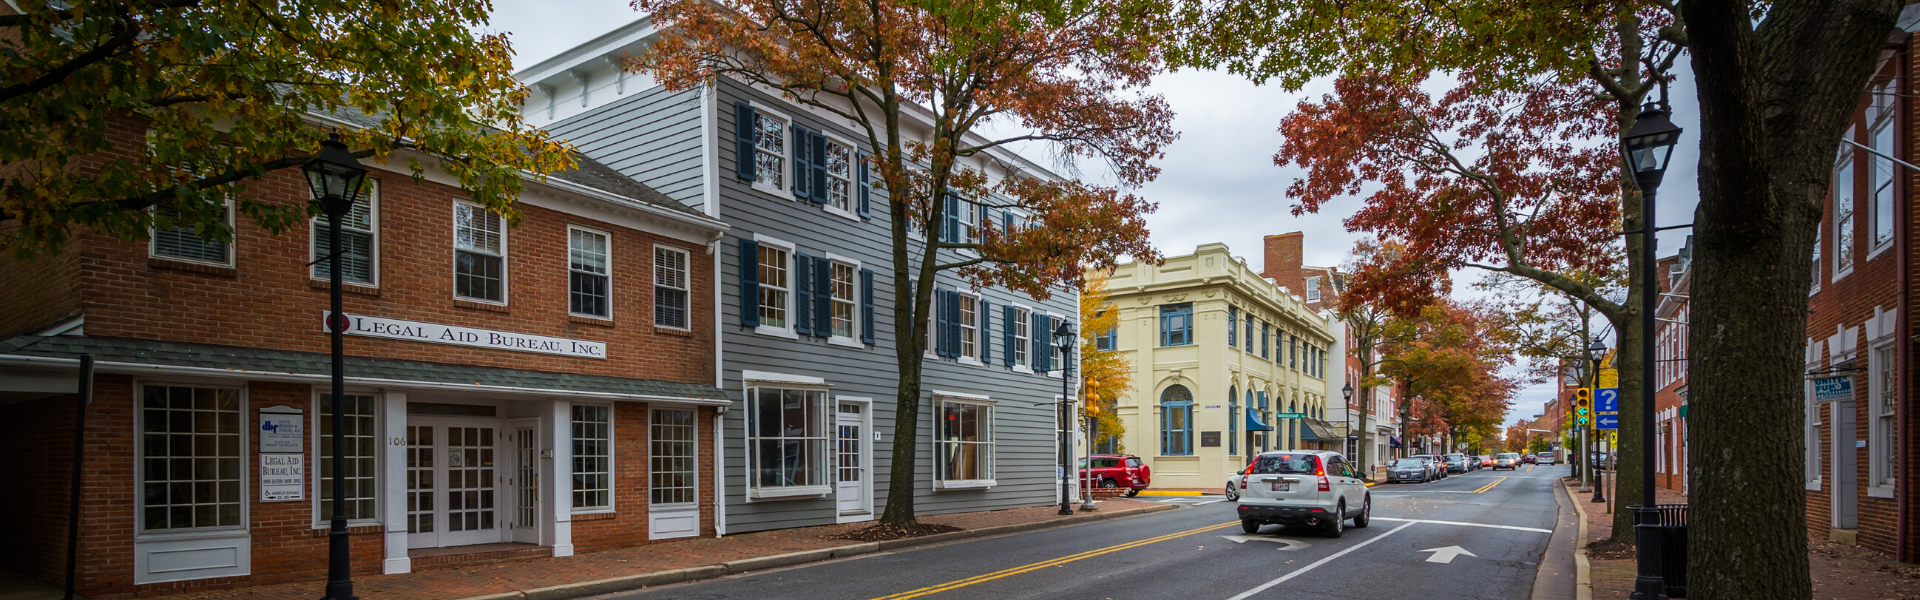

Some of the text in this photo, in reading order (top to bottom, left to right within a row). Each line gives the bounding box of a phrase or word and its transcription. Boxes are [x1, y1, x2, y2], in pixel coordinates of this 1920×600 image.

[355, 317, 601, 356] LEGAL AID BUREAU, INC.
[388, 437, 406, 446] 106
[265, 456, 299, 465] LEGAL AID
[263, 466, 301, 476] BUREAU, INC.
